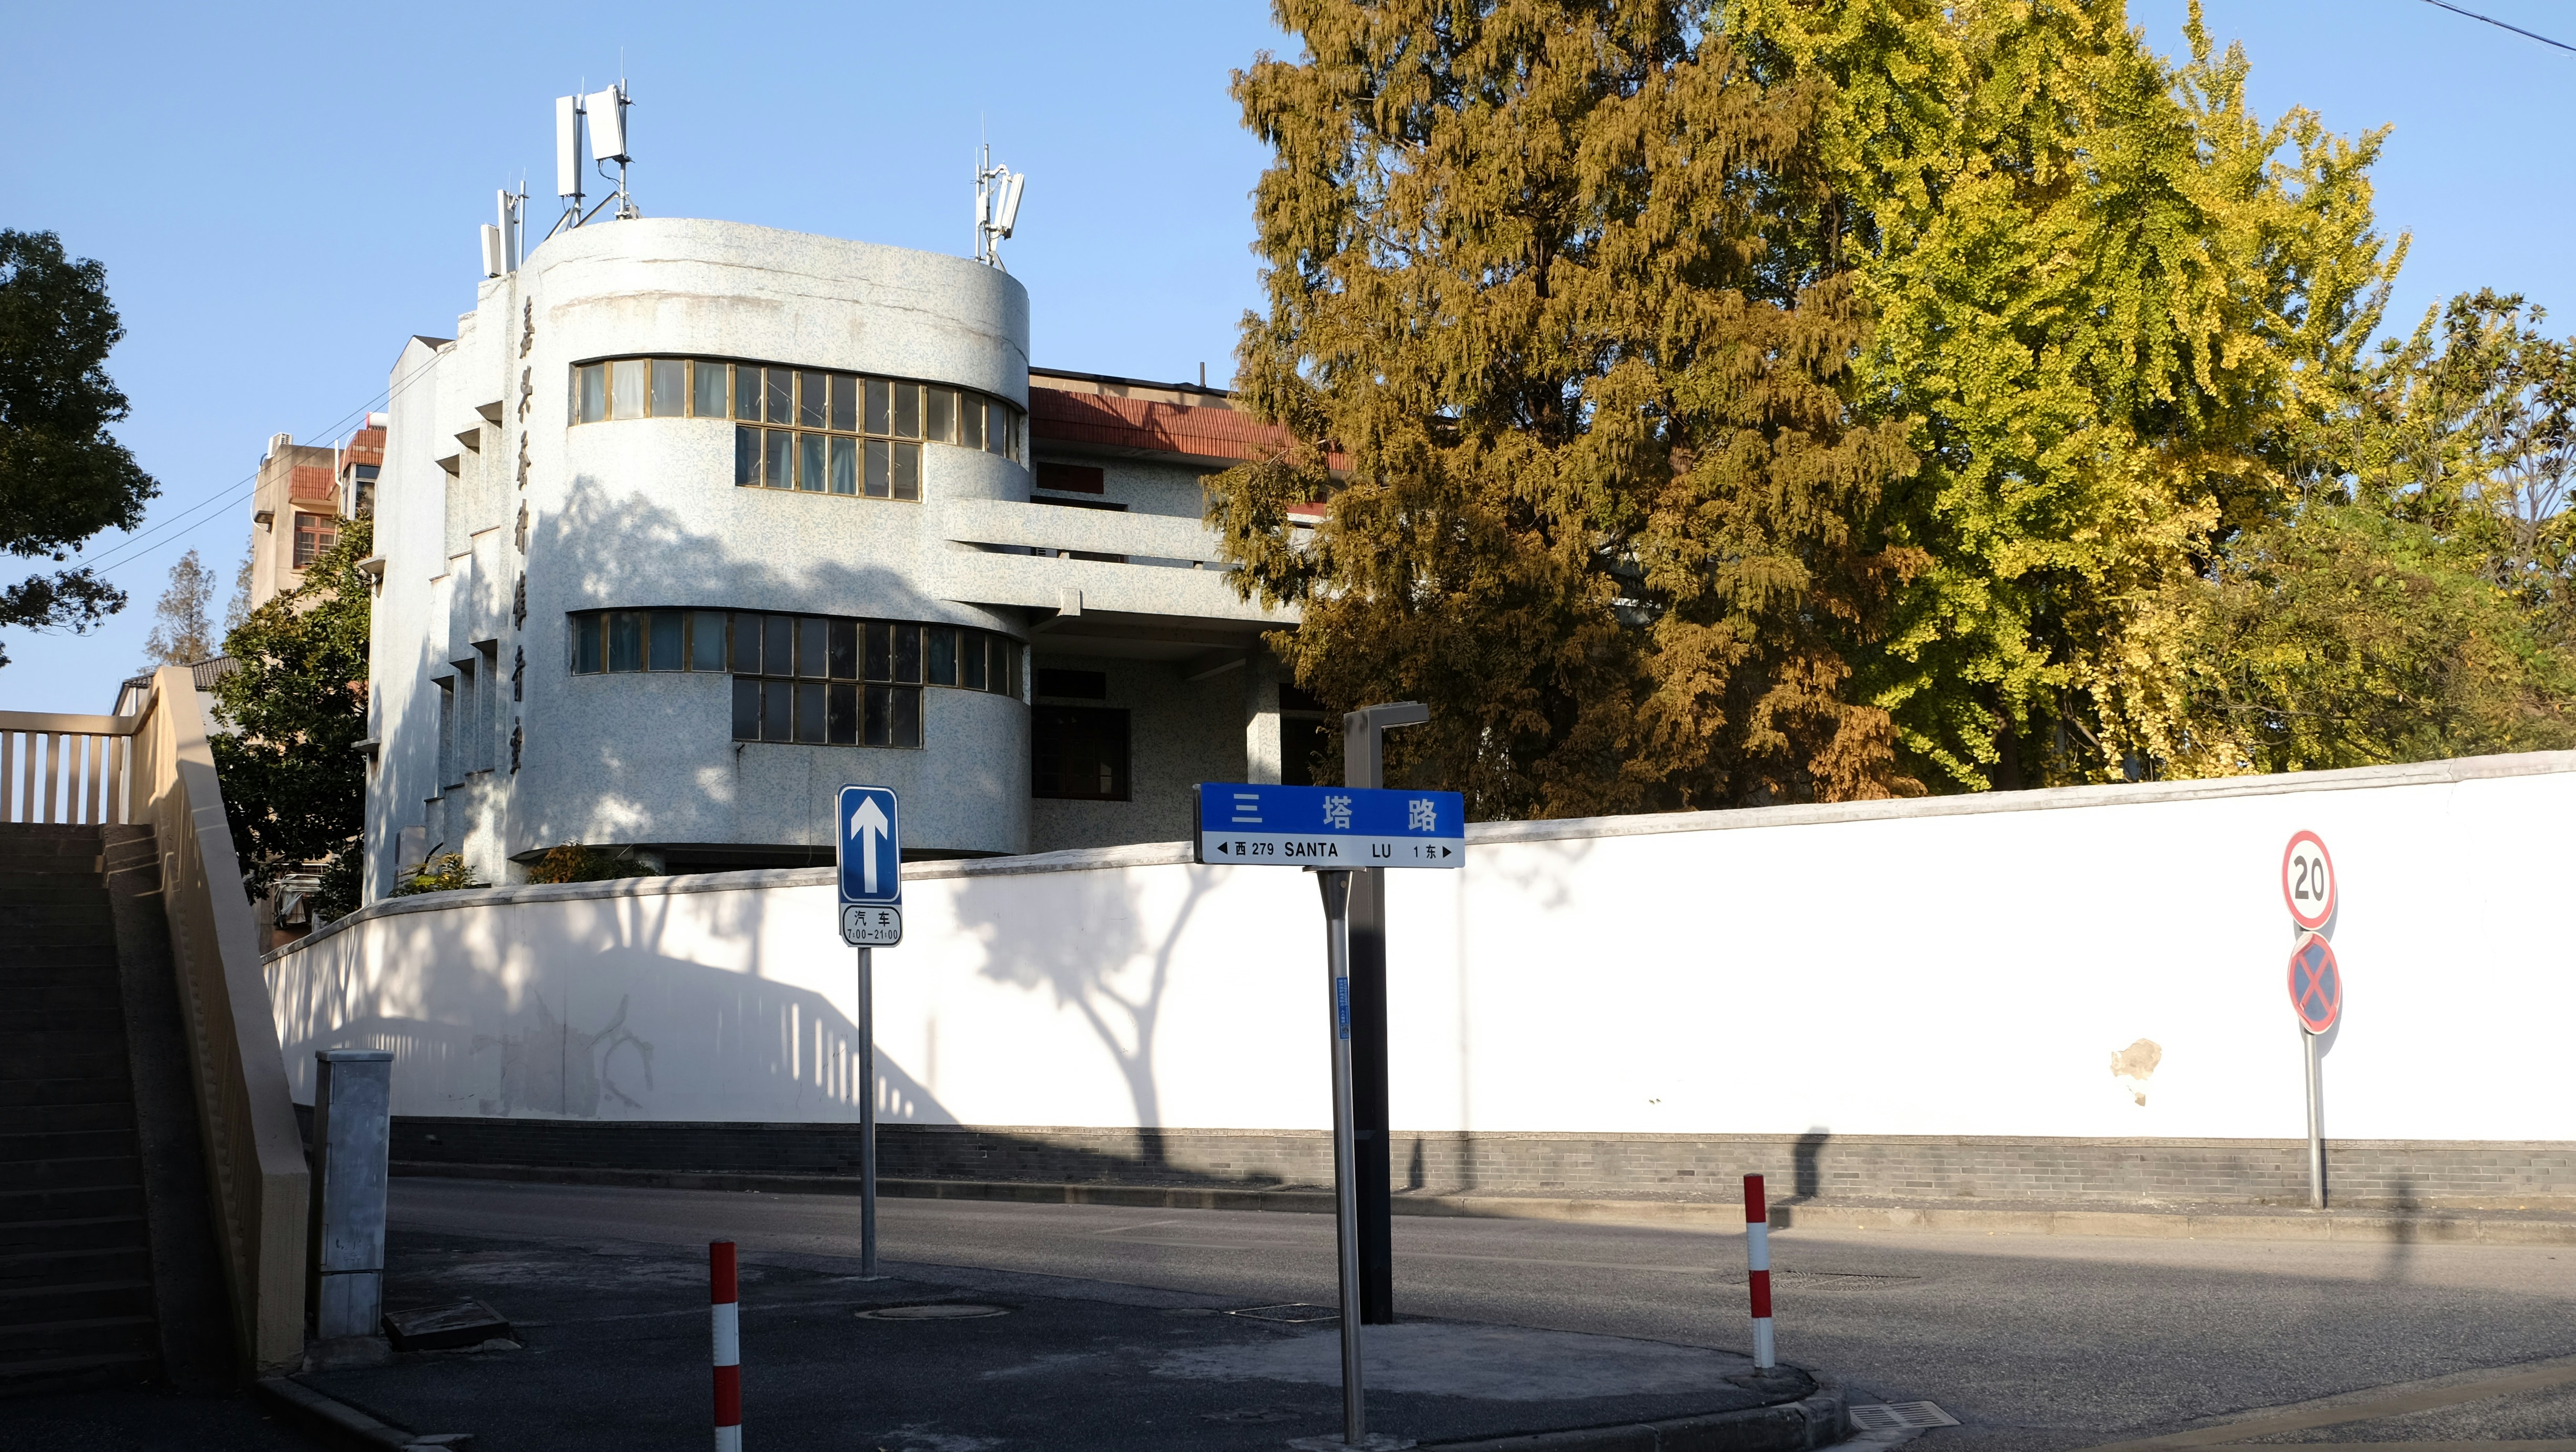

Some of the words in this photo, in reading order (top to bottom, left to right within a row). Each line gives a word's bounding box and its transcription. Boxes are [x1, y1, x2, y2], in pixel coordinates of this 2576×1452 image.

[1232, 793, 1437, 832] 三塔路
[1235, 842, 1246, 856] 西
[1252, 843, 1274, 856] 279
[1284, 842, 1338, 858] SANTA
[1372, 843, 1391, 858] LU
[1413, 846, 1418, 858] 1
[1426, 844, 1437, 859] 东
[2294, 855, 2325, 901] 20
[854, 911, 890, 926] 汽车
